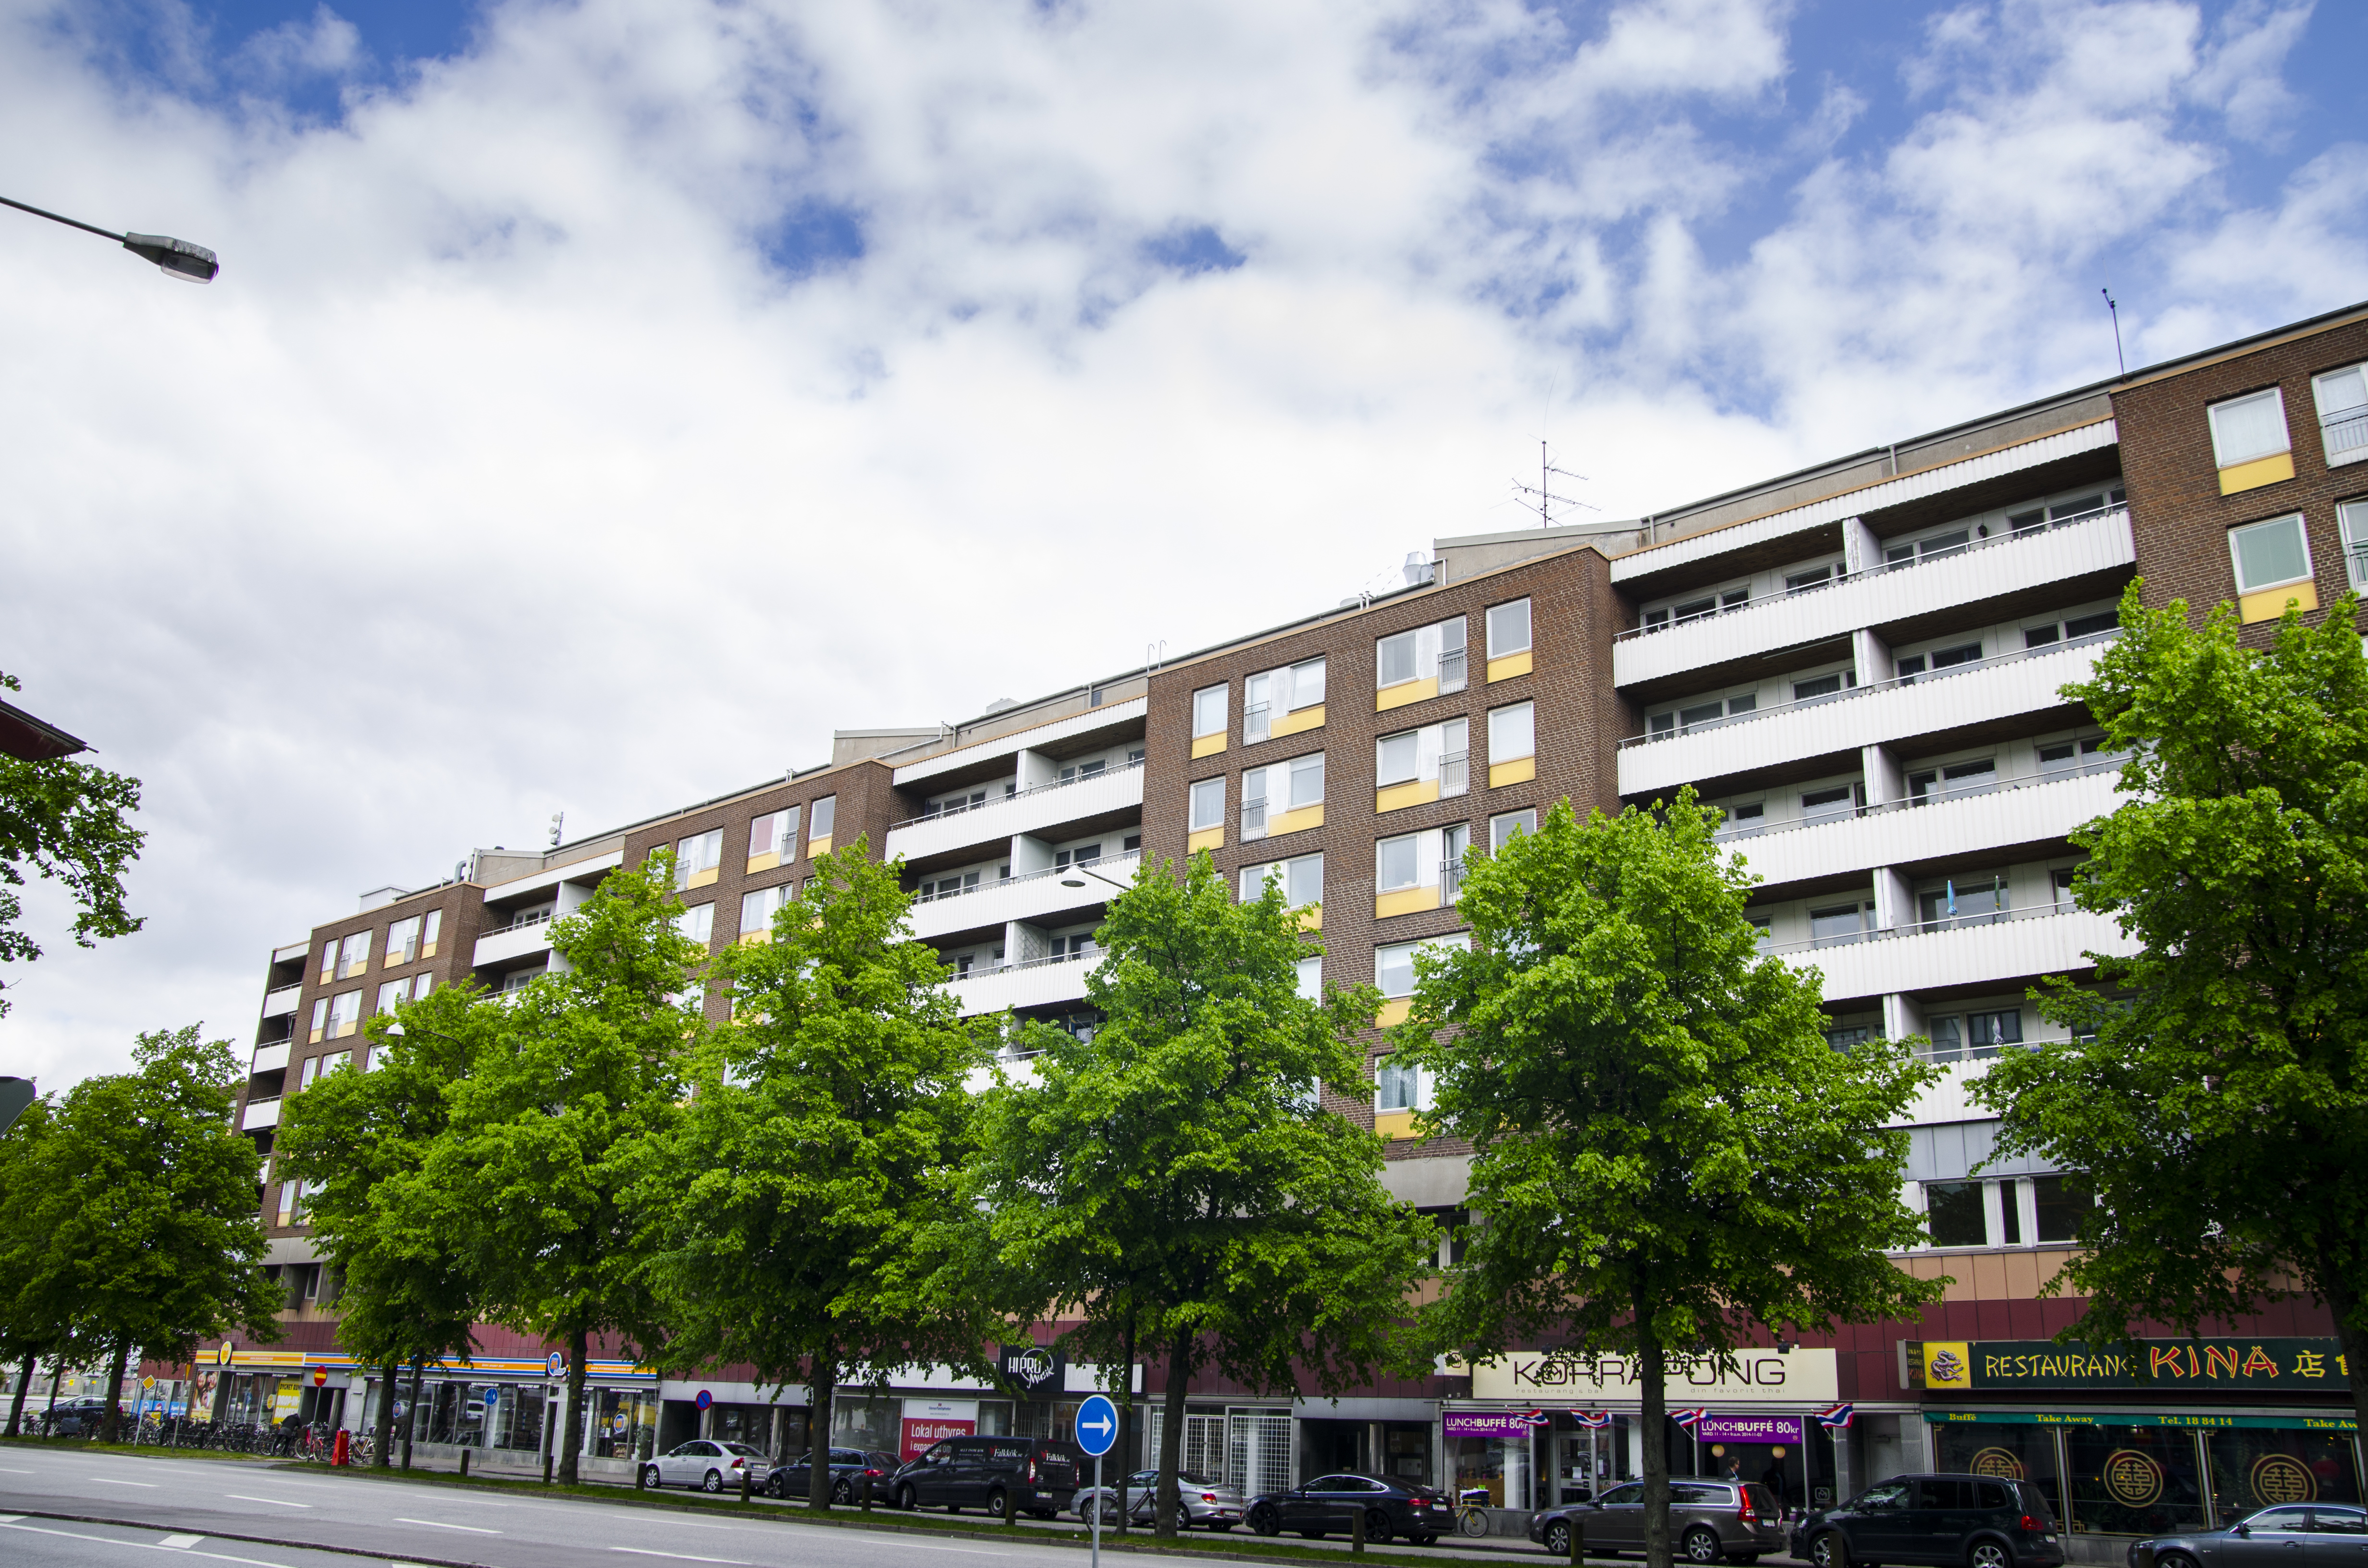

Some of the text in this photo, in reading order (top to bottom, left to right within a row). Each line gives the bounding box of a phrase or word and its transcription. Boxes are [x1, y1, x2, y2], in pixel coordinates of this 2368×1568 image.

[2150, 1345, 2279, 1379] KINA
[1026, 1366, 1055, 1388] Musik
[1446, 1417, 1506, 1427] LUNCHBUFFÉ
[2064, 1415, 2094, 1423] Away
[2304, 1419, 2358, 1429] Take Aw
[911, 1423, 966, 1439] Lokal uthyres
[1702, 1420, 1799, 1433] LUNCHBUFFÉ 80kr
